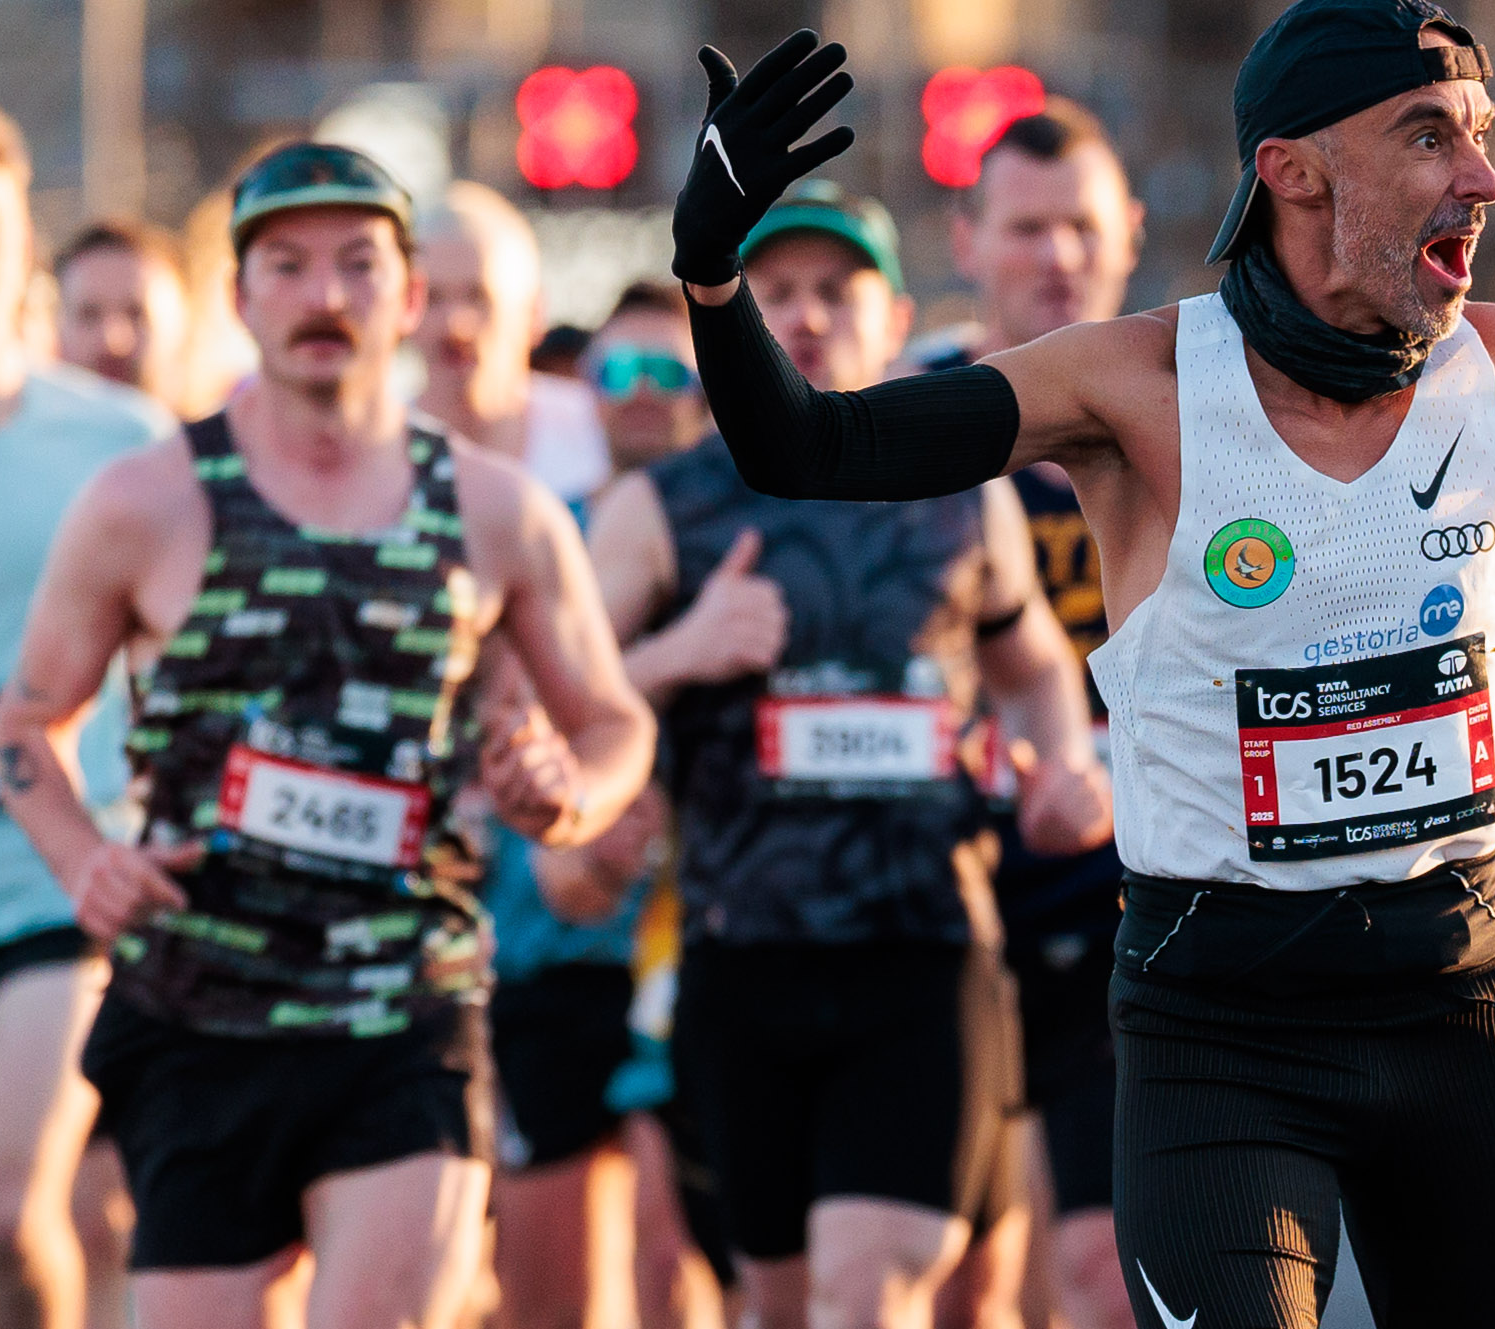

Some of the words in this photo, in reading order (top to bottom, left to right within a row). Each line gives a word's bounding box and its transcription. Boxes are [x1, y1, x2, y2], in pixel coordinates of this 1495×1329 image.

[1423, 600, 1461, 624] me
[1316, 680, 1350, 693] TATA
[1317, 683, 1391, 705] CONSULTANCY
[1435, 675, 1473, 696] TATA
[1257, 686, 1312, 720] tcs
[1318, 700, 1366, 717] SERVICES
[1346, 722, 1362, 731] RED
[1363, 714, 1402, 729] ASSEMBLY
[1244, 740, 1269, 749] START
[1244, 749, 1271, 758] GROUP
[1474, 740, 1489, 764] A
[1313, 742, 1437, 803] 1524
[1253, 775, 1264, 797] 1
[1250, 812, 1274, 822] 2025
[1346, 825, 1373, 843] tcs
[1373, 826, 1418, 839] MARATHON
